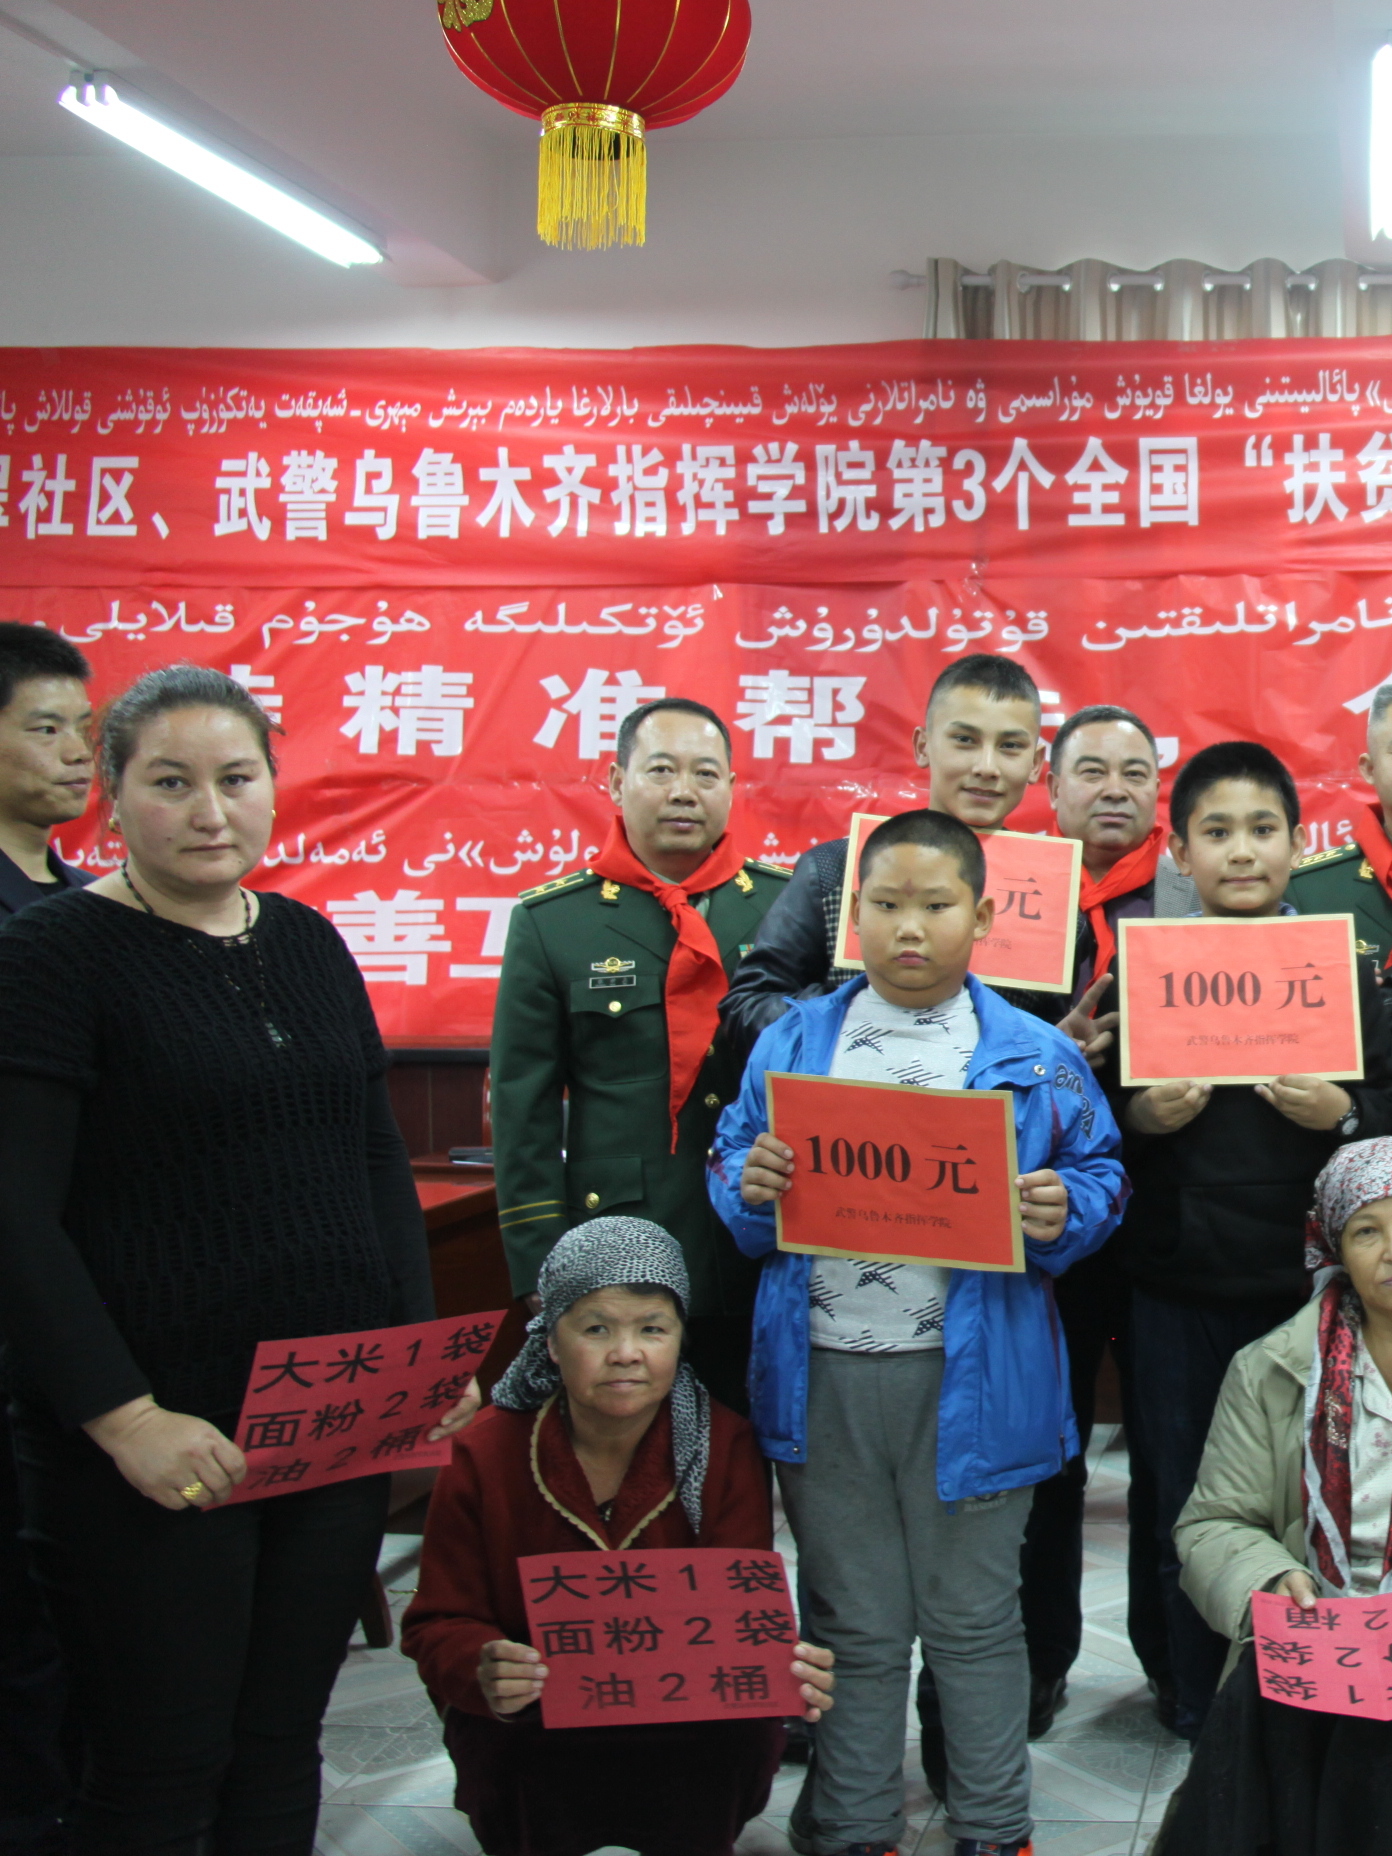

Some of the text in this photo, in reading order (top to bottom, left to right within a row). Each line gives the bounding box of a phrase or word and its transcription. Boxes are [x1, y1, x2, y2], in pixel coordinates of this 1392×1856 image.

[996, 877, 1043, 921] 元
[1159, 962, 1326, 1010] 1000 元
[805, 1135, 980, 1195] 1000 元
